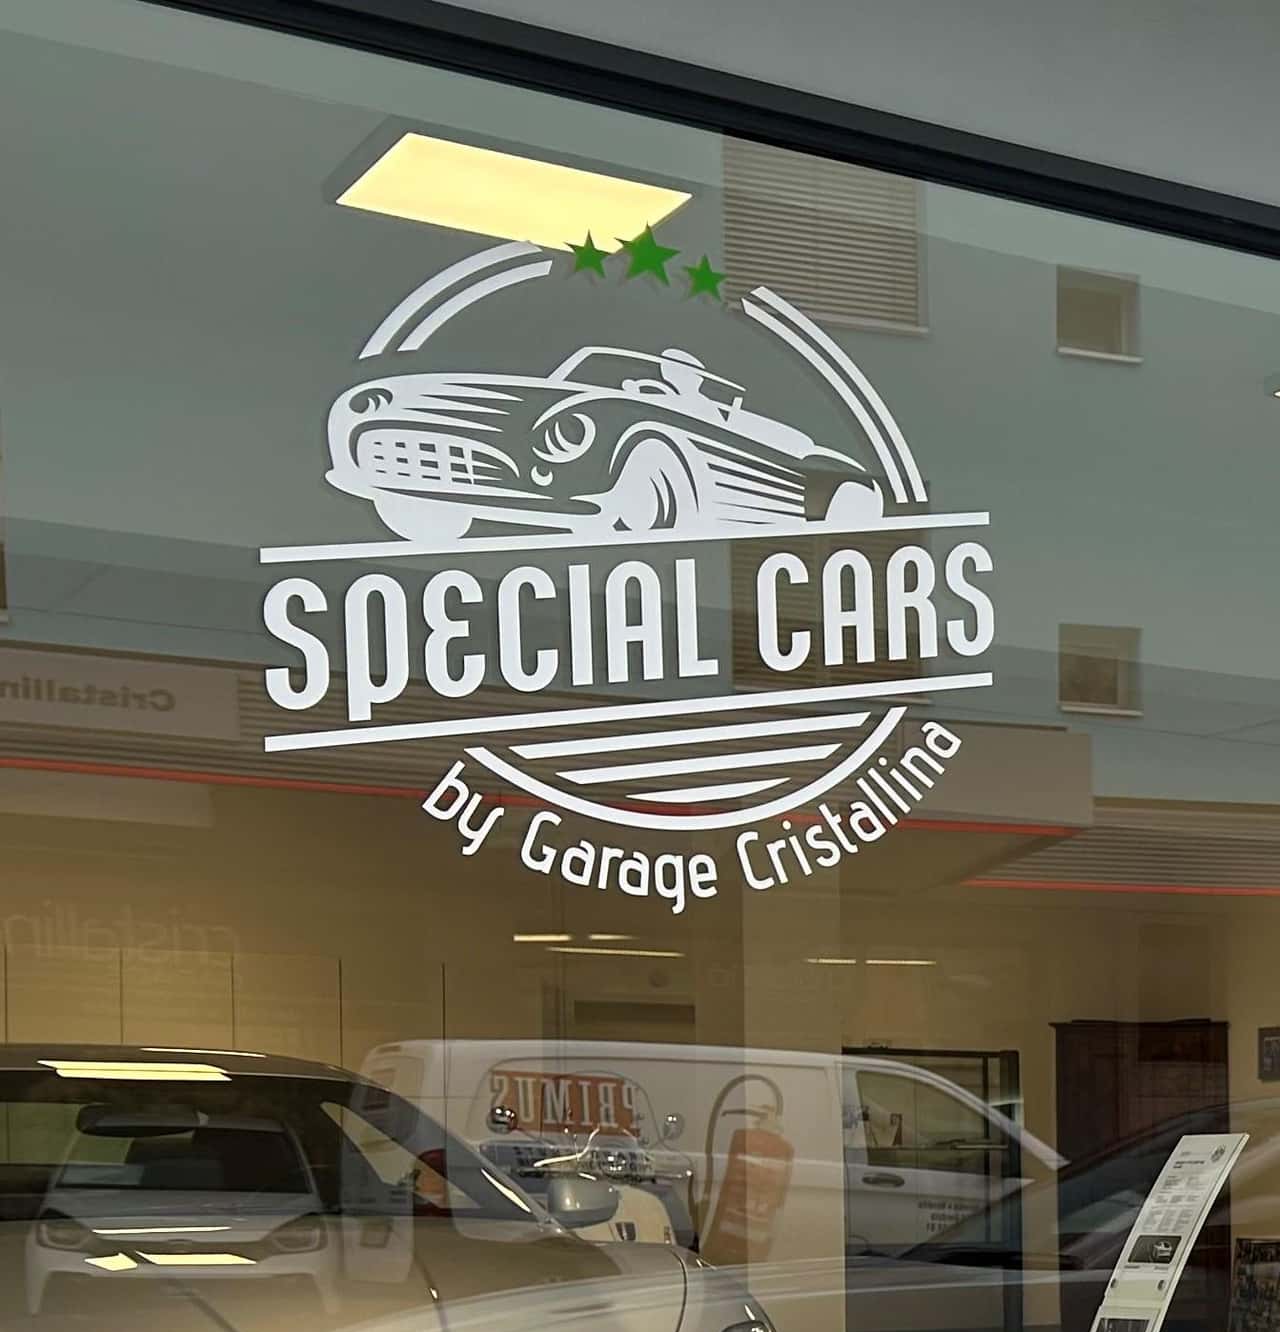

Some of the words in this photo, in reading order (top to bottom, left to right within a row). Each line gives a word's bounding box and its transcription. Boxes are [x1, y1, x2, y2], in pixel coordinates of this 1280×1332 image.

[263, 558, 719, 721] SPECIAL
[756, 542, 995, 673] CARS
[422, 759, 504, 856] by
[520, 812, 718, 915] Garage
[736, 719, 962, 891] Cristallina
